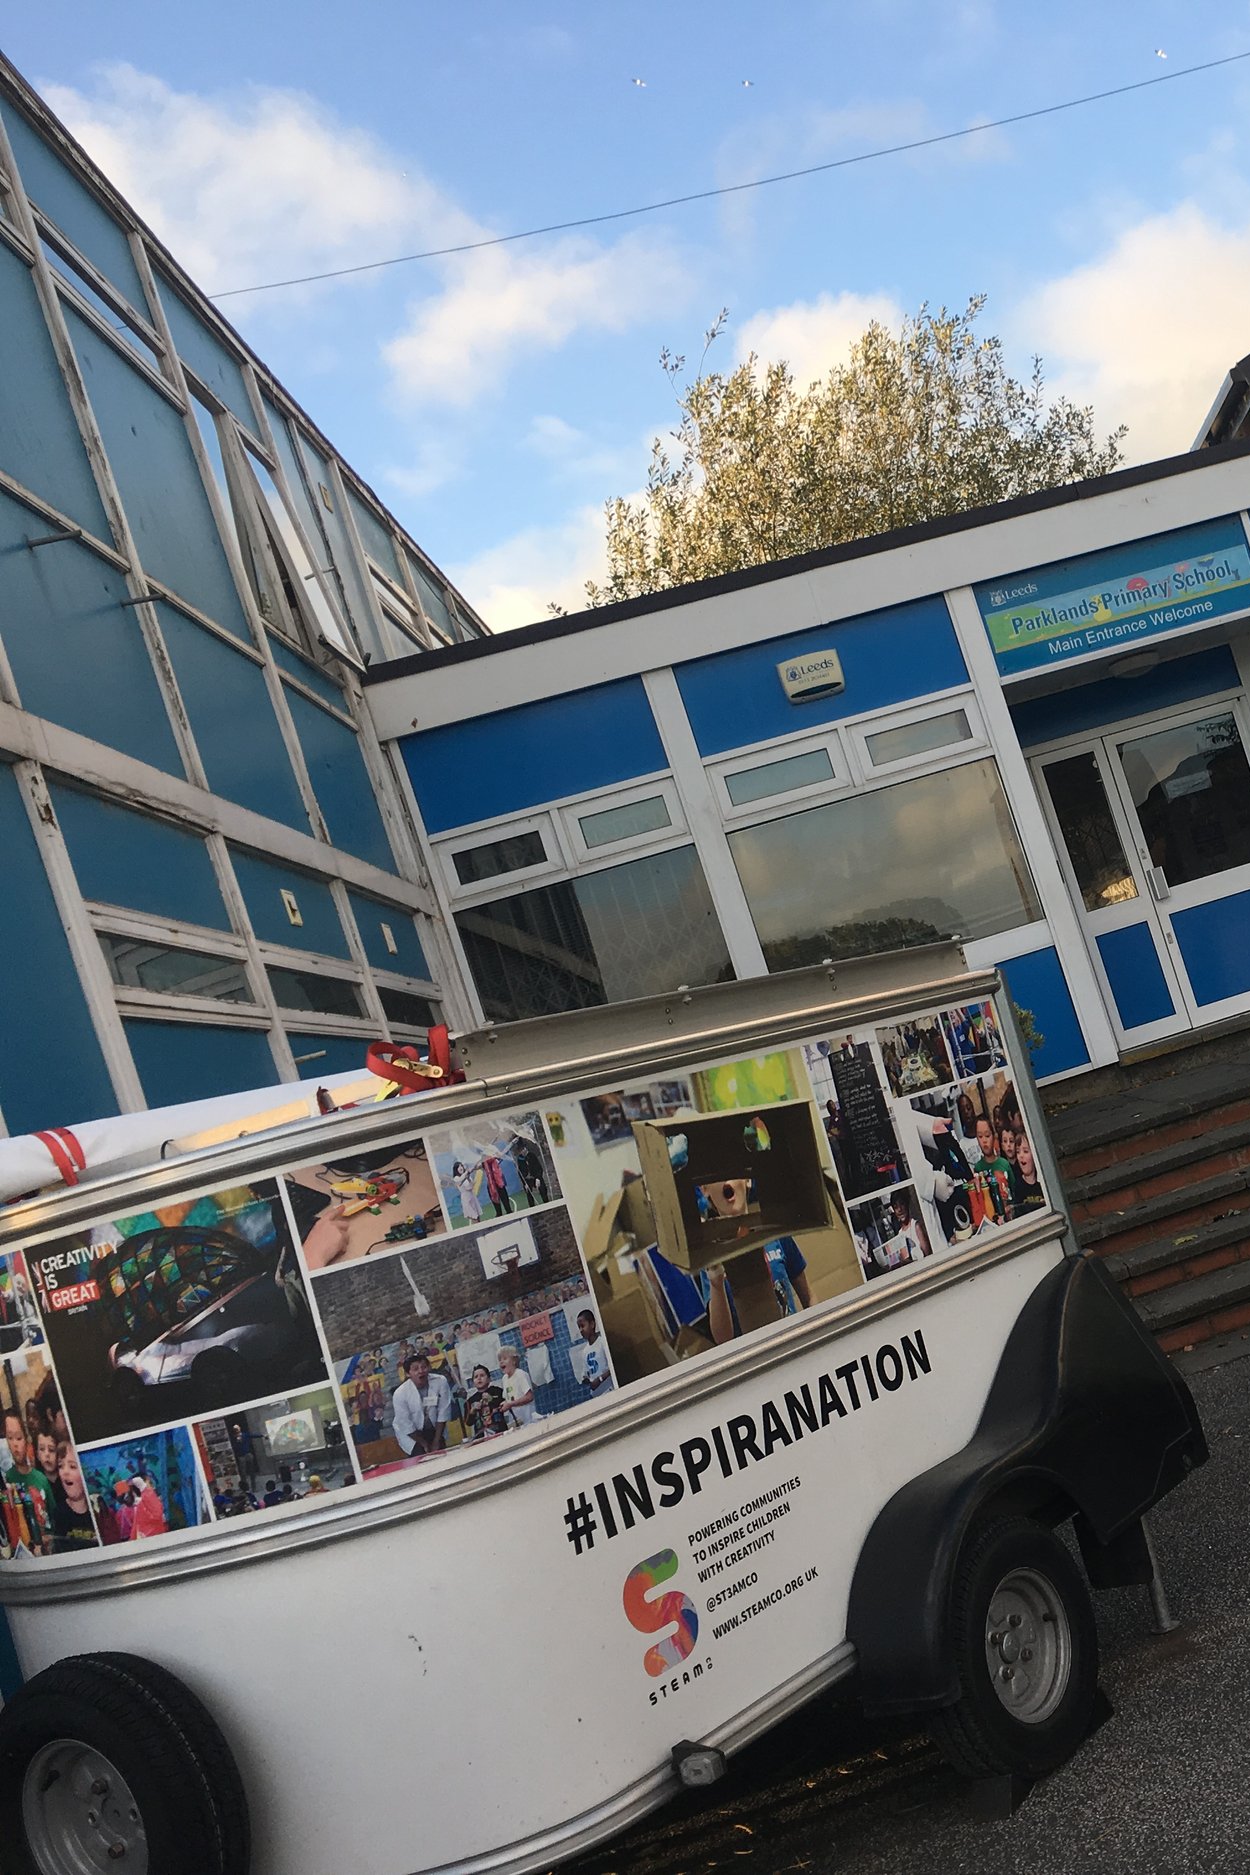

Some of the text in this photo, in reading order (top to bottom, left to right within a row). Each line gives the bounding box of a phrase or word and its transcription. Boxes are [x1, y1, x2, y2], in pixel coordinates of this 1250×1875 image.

[1005, 583, 1038, 600] Leeds
[1011, 560, 1232, 635] Parklands Primary School
[1048, 600, 1214, 655] Main Entrance Welcome
[800, 659, 834, 675] Leeds
[40, 1240, 118, 1274] CREATIVITY
[44, 1273, 58, 1291] IS
[51, 1282, 97, 1308] GREAT
[563, 1329, 933, 1556] #INSPIRANATION
[687, 1476, 801, 1547] POWERING COMMUNITIES
[692, 1501, 791, 1564] TO INSPIRE CHILDREN
[697, 1530, 776, 1583] WITH CREATIVITY
[706, 1572, 758, 1613] @ST3AMCO
